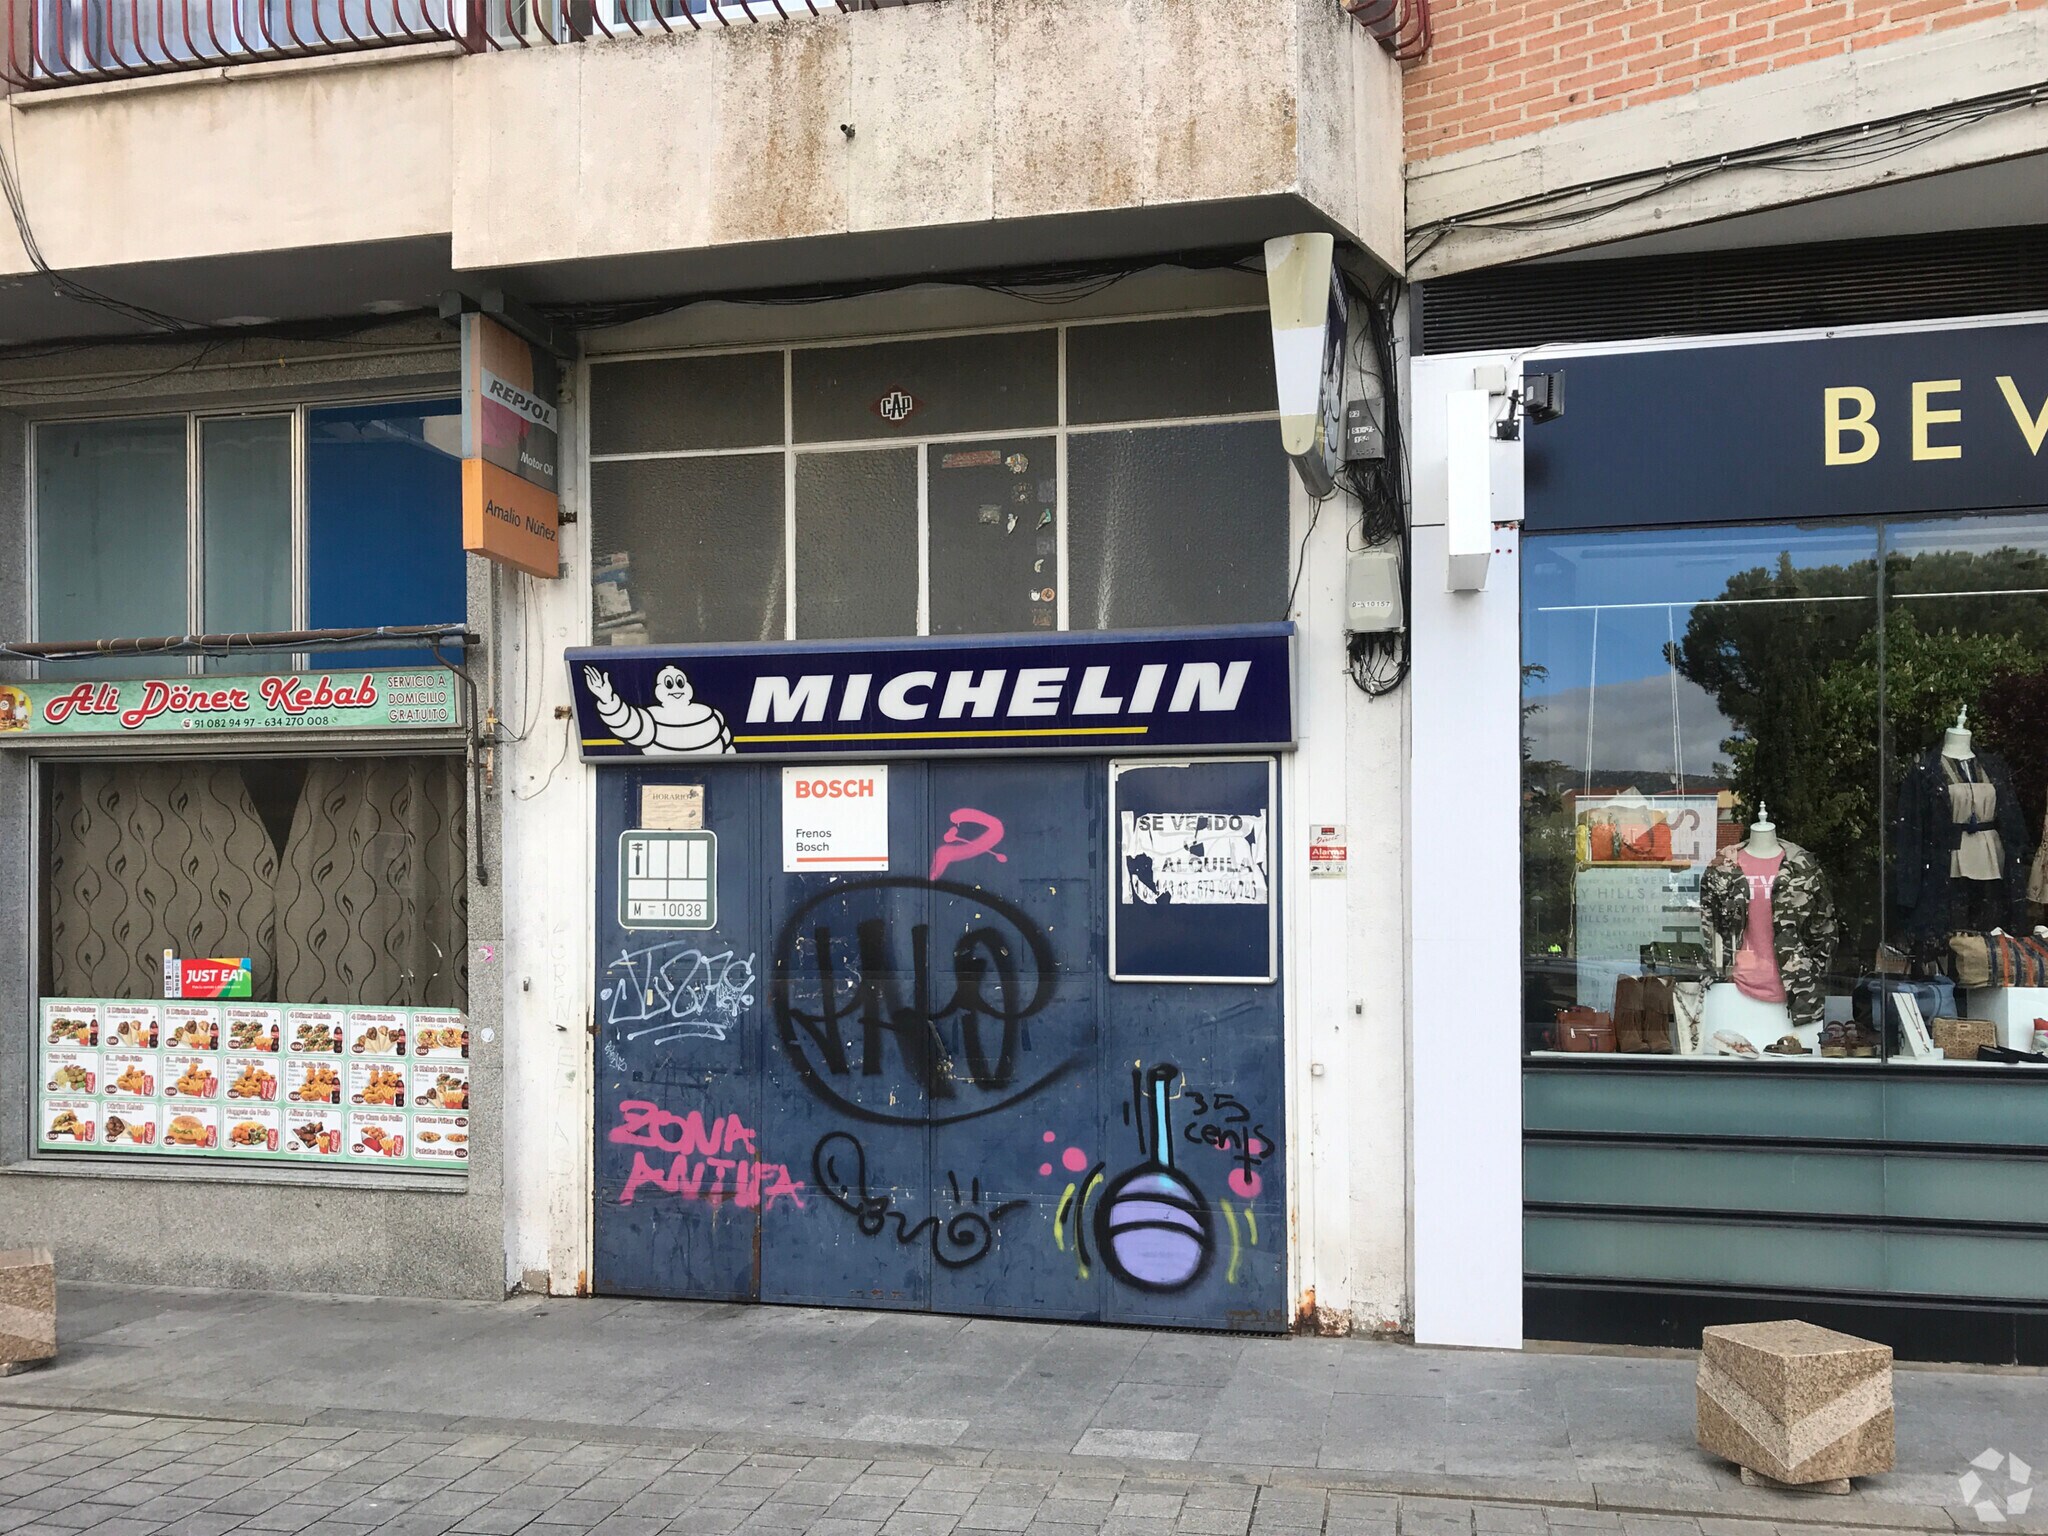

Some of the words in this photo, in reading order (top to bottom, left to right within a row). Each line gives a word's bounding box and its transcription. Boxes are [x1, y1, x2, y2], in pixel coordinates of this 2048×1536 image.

[489, 380, 550, 424] REPSOL
[881, 392, 912, 420] CAP
[521, 452, 542, 471] Motor
[543, 464, 553, 476] Oil
[486, 500, 521, 527] Amalio
[526, 515, 556, 541] Núñez
[387, 675, 434, 688] SERVICIO
[437, 675, 446, 686] A
[388, 692, 447, 705] DOMICILIO
[746, 660, 1251, 723] MICHELIN
[44, 682, 120, 724] Ali
[120, 680, 249, 729] Döner
[260, 673, 378, 714] Kebab
[194, 719, 204, 729] 91
[207, 719, 226, 729] 082
[229, 718, 241, 728] 94
[243, 718, 255, 728] 97
[264, 718, 284, 727] 634
[286, 717, 304, 726] 270
[307, 717, 329, 726] 008
[389, 708, 449, 722] GRATUITO
[795, 779, 874, 798] BOSCH
[1139, 815, 1164, 831] SE
[1170, 815, 1243, 831] VEDO
[796, 829, 832, 838] Frenos
[796, 842, 830, 852] Bosch
[1312, 847, 1345, 855] Alarma
[1161, 857, 1253, 873] ALQUILA
[1597, 888, 1646, 900] HILLS
[634, 902, 642, 916] M
[662, 903, 702, 917] 10038
[186, 969, 218, 984] JUST
[220, 969, 247, 982] EAT
[1185, 1092, 1250, 1122] 35
[609, 1100, 756, 1156] ZONA
[415, 1147, 437, 1155] Patatas
[1184, 1122, 1275, 1185] cents
[619, 1151, 805, 1210] ANTIFA
